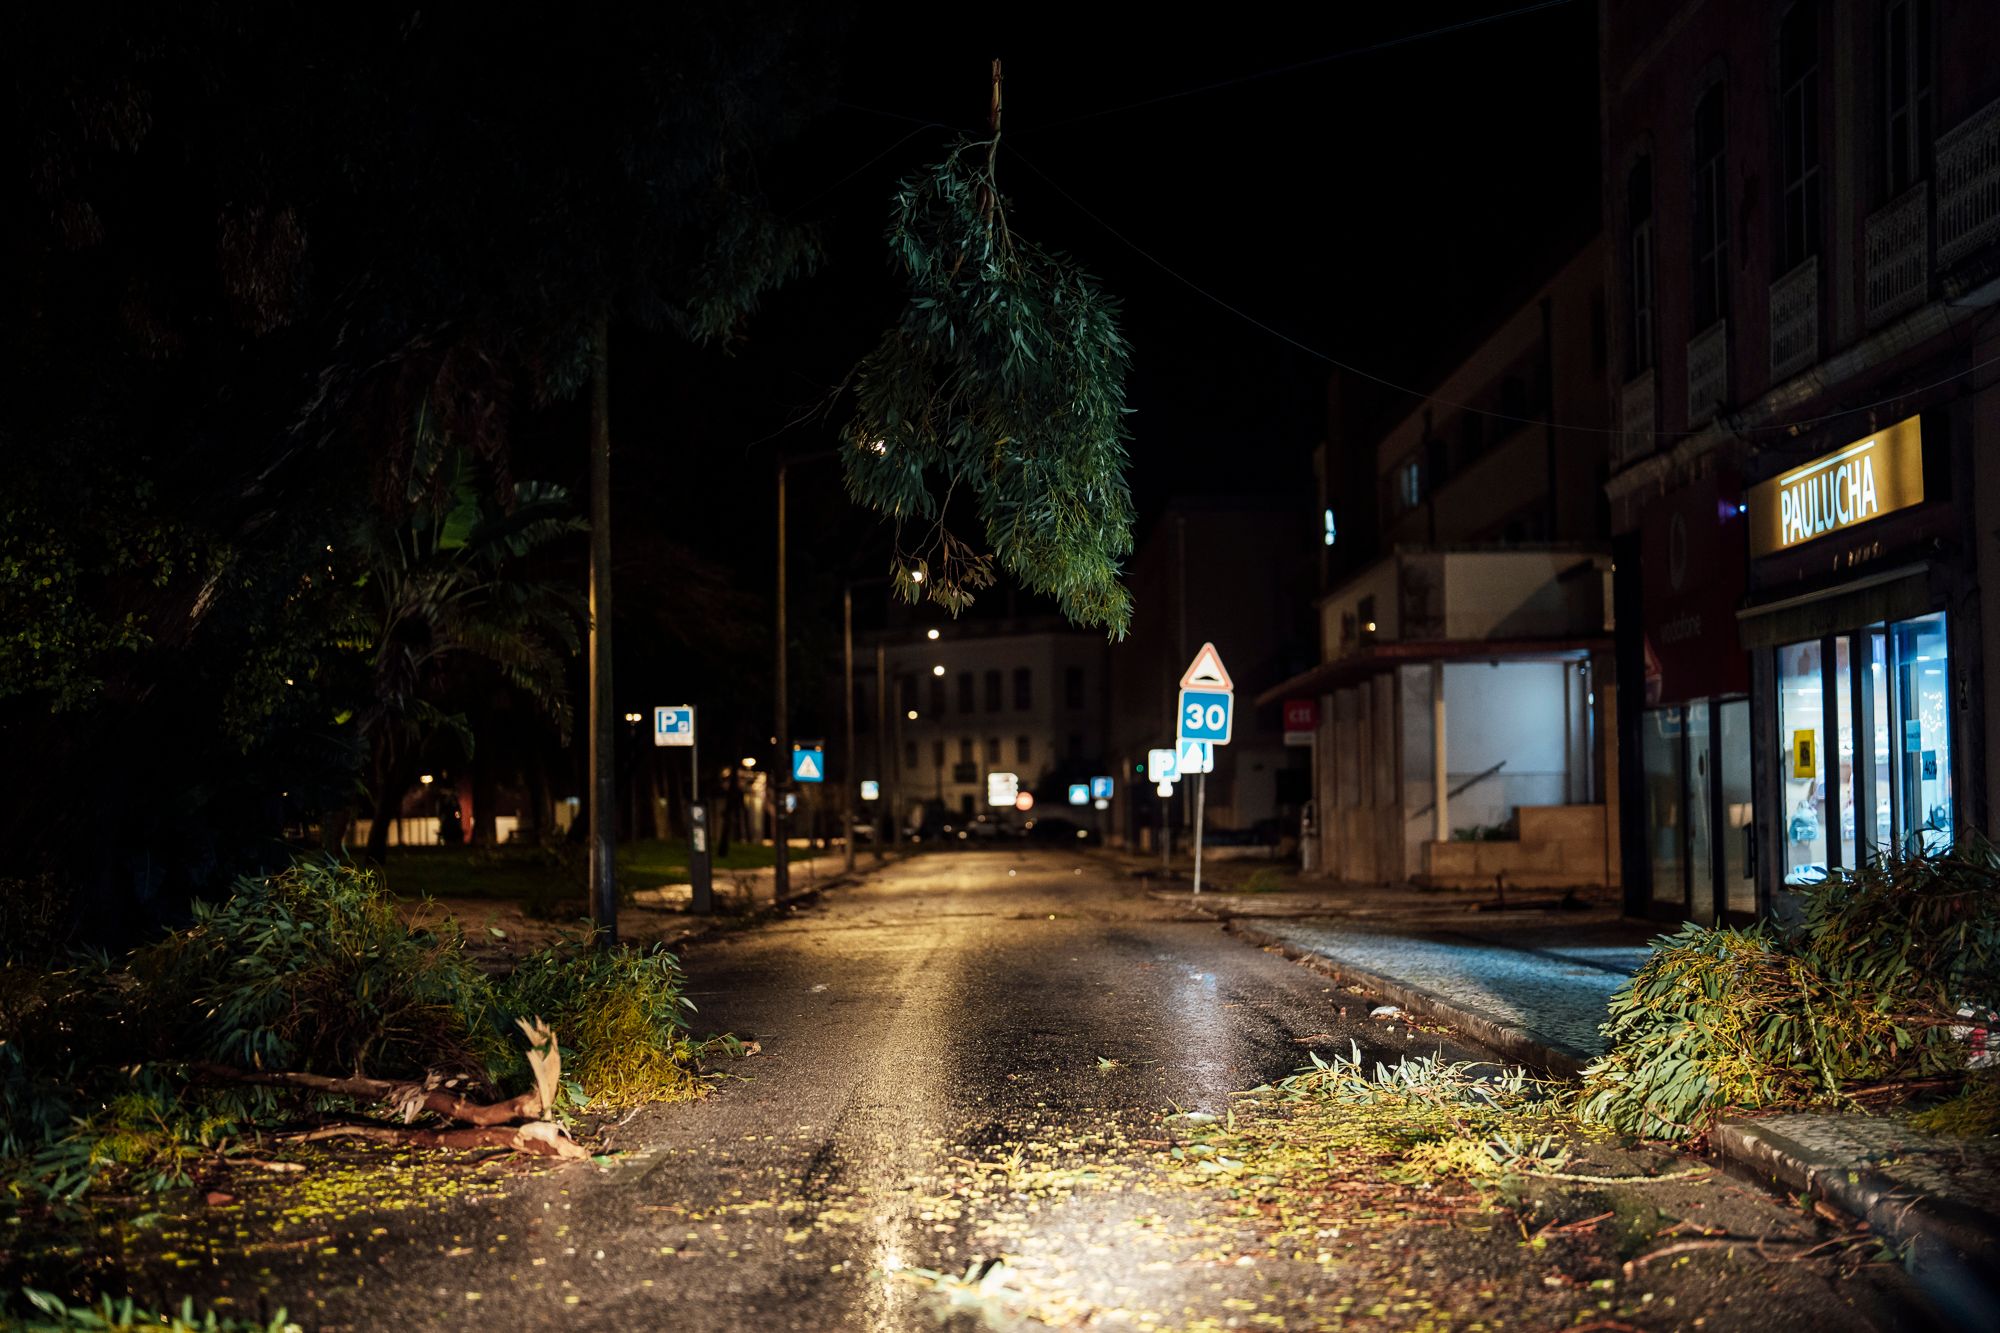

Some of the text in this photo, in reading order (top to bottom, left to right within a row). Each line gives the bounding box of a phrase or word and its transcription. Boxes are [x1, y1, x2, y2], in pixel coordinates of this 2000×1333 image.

[1781, 455, 1878, 545] PAULUCHA
[661, 712, 678, 732] P
[1186, 703, 1226, 731] 30
